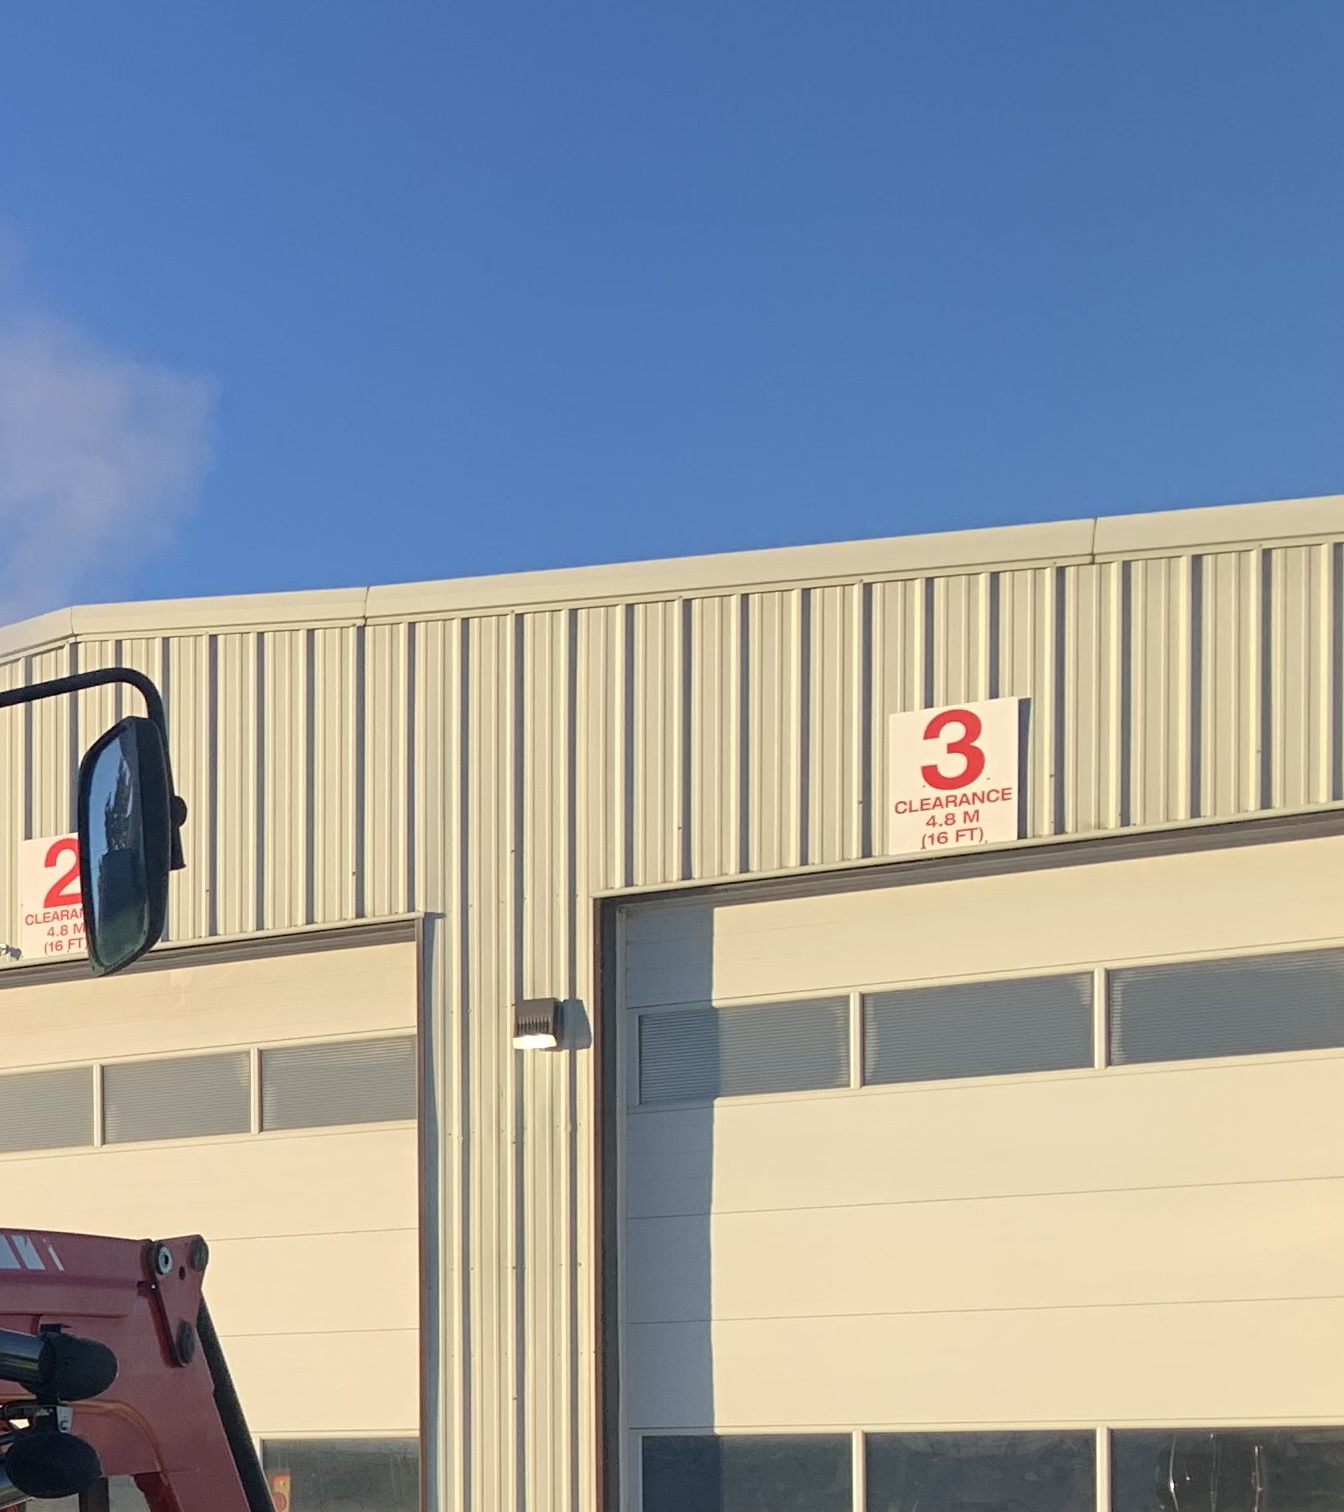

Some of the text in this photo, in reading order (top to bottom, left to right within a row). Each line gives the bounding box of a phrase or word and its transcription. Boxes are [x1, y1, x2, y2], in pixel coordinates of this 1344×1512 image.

[921, 708, 986, 791] 3
[894, 787, 1013, 815] CLEARANCE
[925, 808, 980, 829] 4.8 M
[920, 826, 985, 850] (16 FT)
[43, 837, 82, 909] 2
[47, 922, 87, 938] 4.8 M
[44, 937, 88, 956] (16 FT
